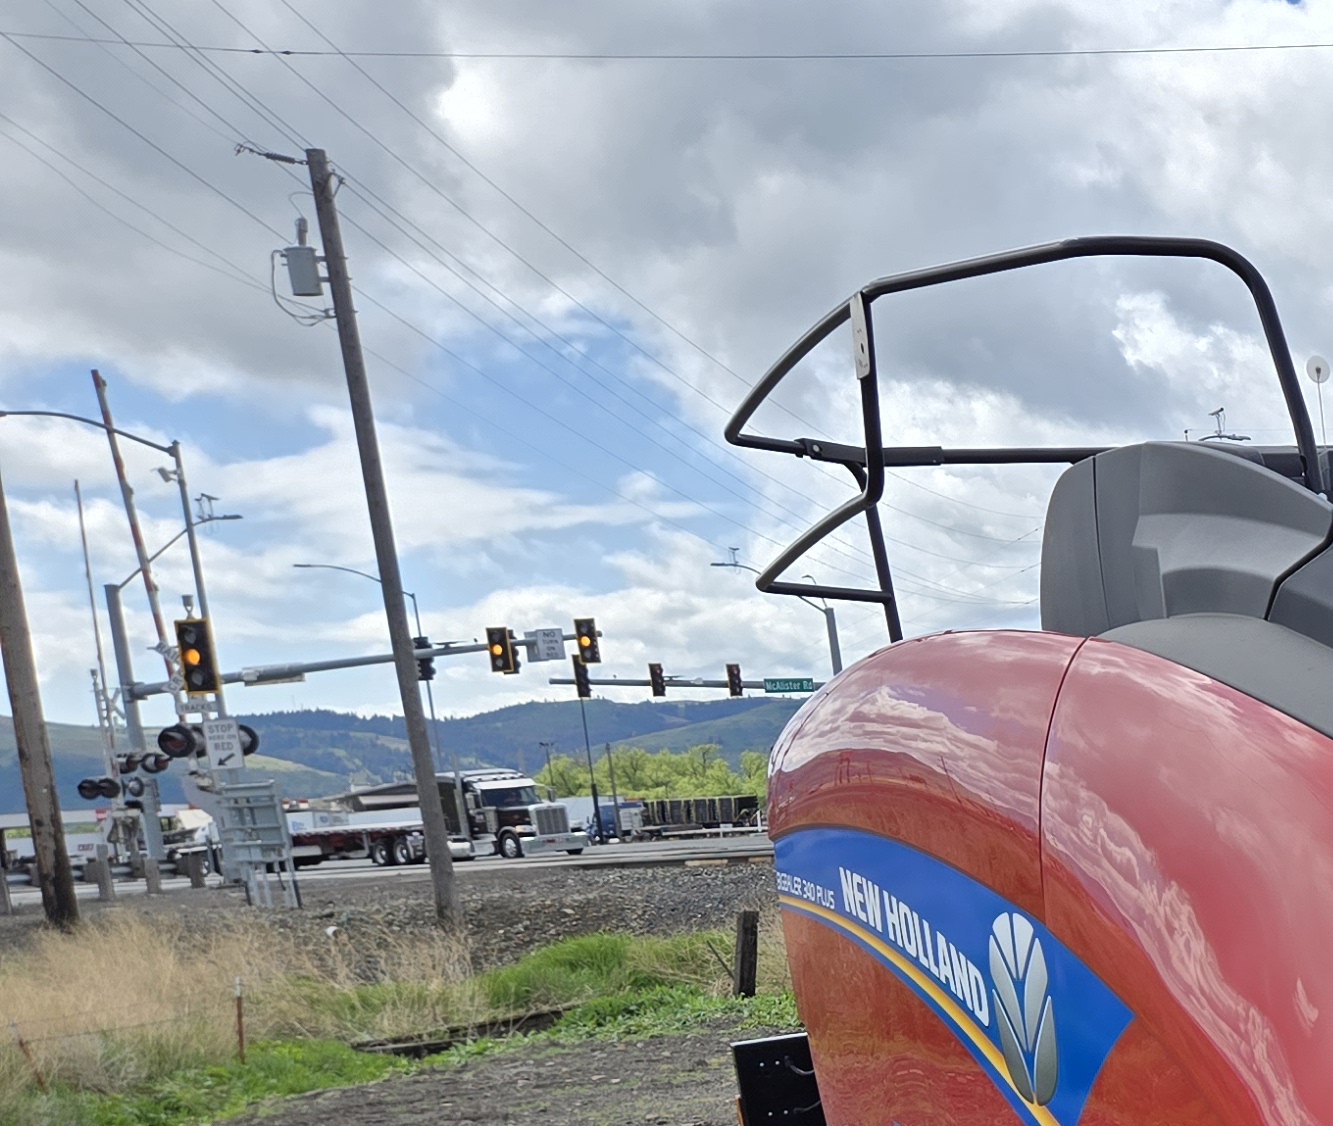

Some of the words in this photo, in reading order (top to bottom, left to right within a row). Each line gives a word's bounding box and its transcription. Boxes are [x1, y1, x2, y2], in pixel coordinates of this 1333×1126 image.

[543, 631, 556, 639] NO
[803, 680, 813, 690] Rd
[207, 723, 234, 734] STOP
[213, 742, 234, 751] RED
[803, 879, 816, 902] 340
[816, 884, 835, 910] PLUS
[839, 866, 883, 933] NEW
[882, 889, 990, 1027] HOLLAND
